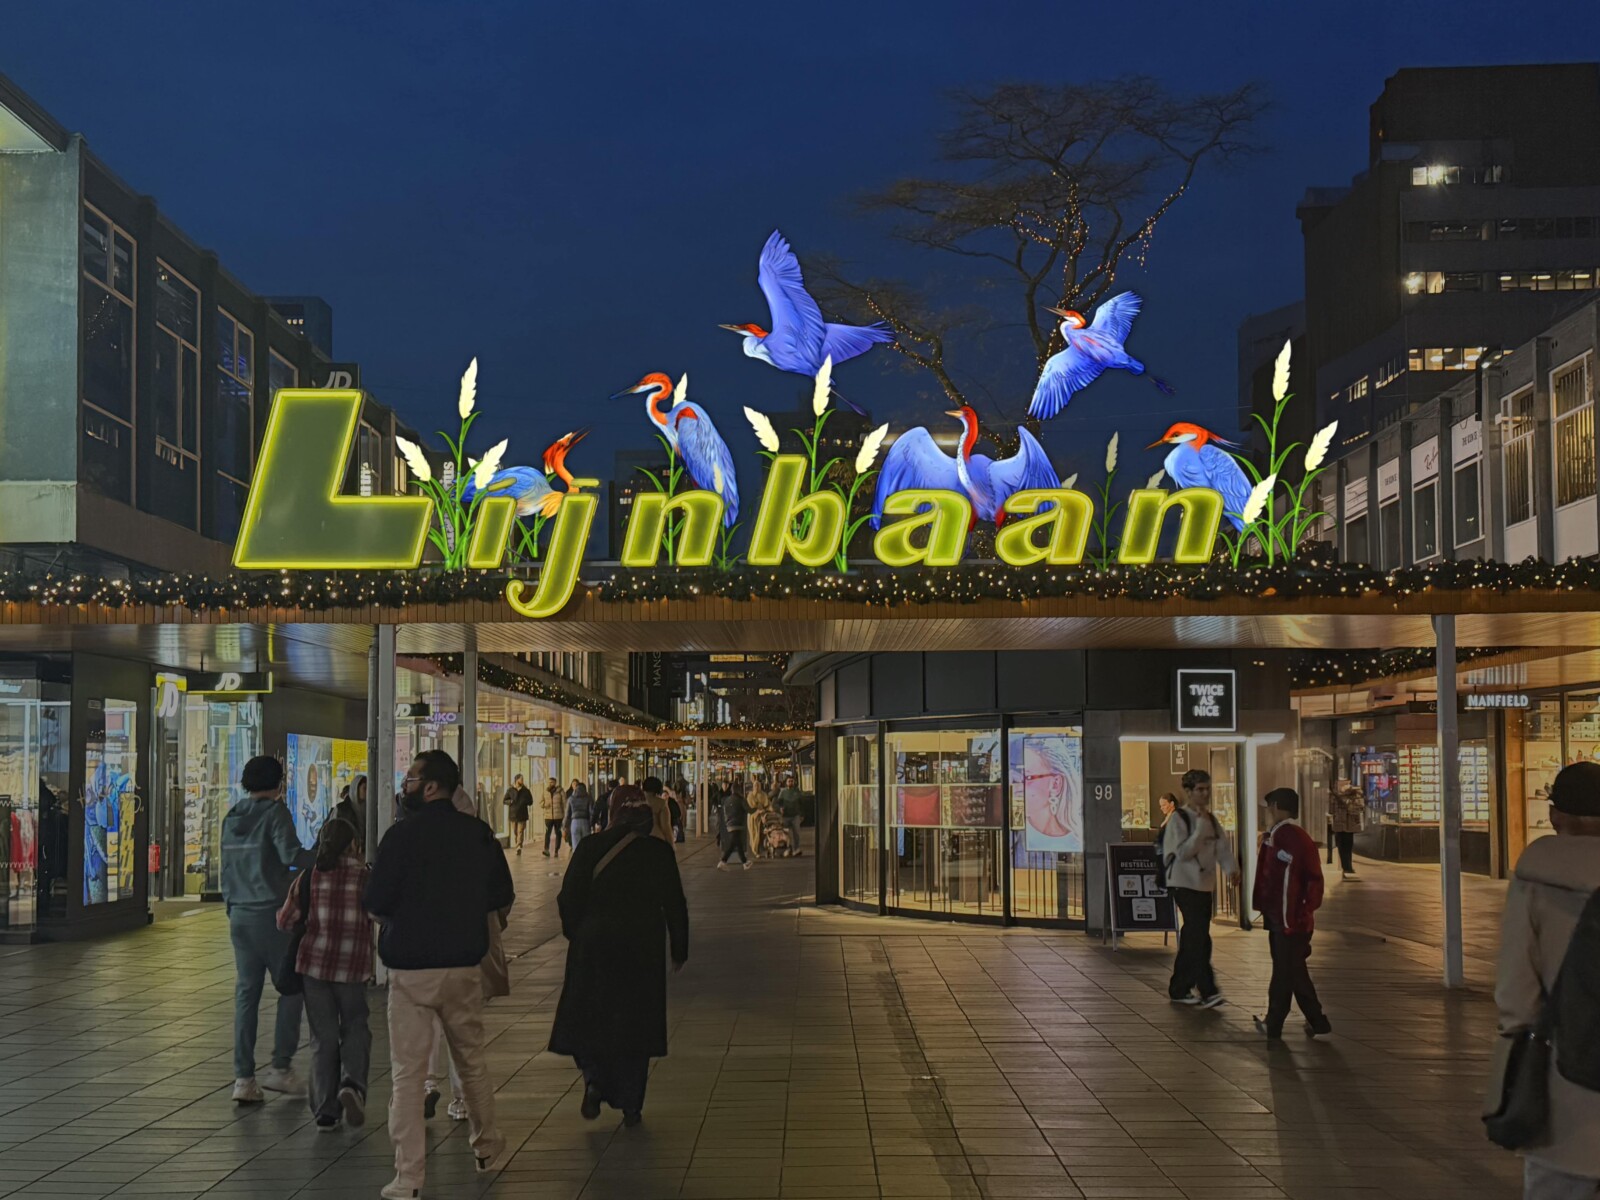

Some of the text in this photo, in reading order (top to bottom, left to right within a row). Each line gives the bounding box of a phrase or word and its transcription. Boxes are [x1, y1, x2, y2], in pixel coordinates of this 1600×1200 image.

[321, 371, 352, 389] JD
[232, 387, 1223, 618] Lijnbaan
[214, 672, 241, 691] JD
[1189, 684, 1225, 696] TWICE
[158, 682, 179, 718] JD
[1199, 695, 1215, 706] AS
[1467, 694, 1529, 707] MANFIELD
[1193, 705, 1220, 717] NICE
[1094, 784, 1113, 801] 98
